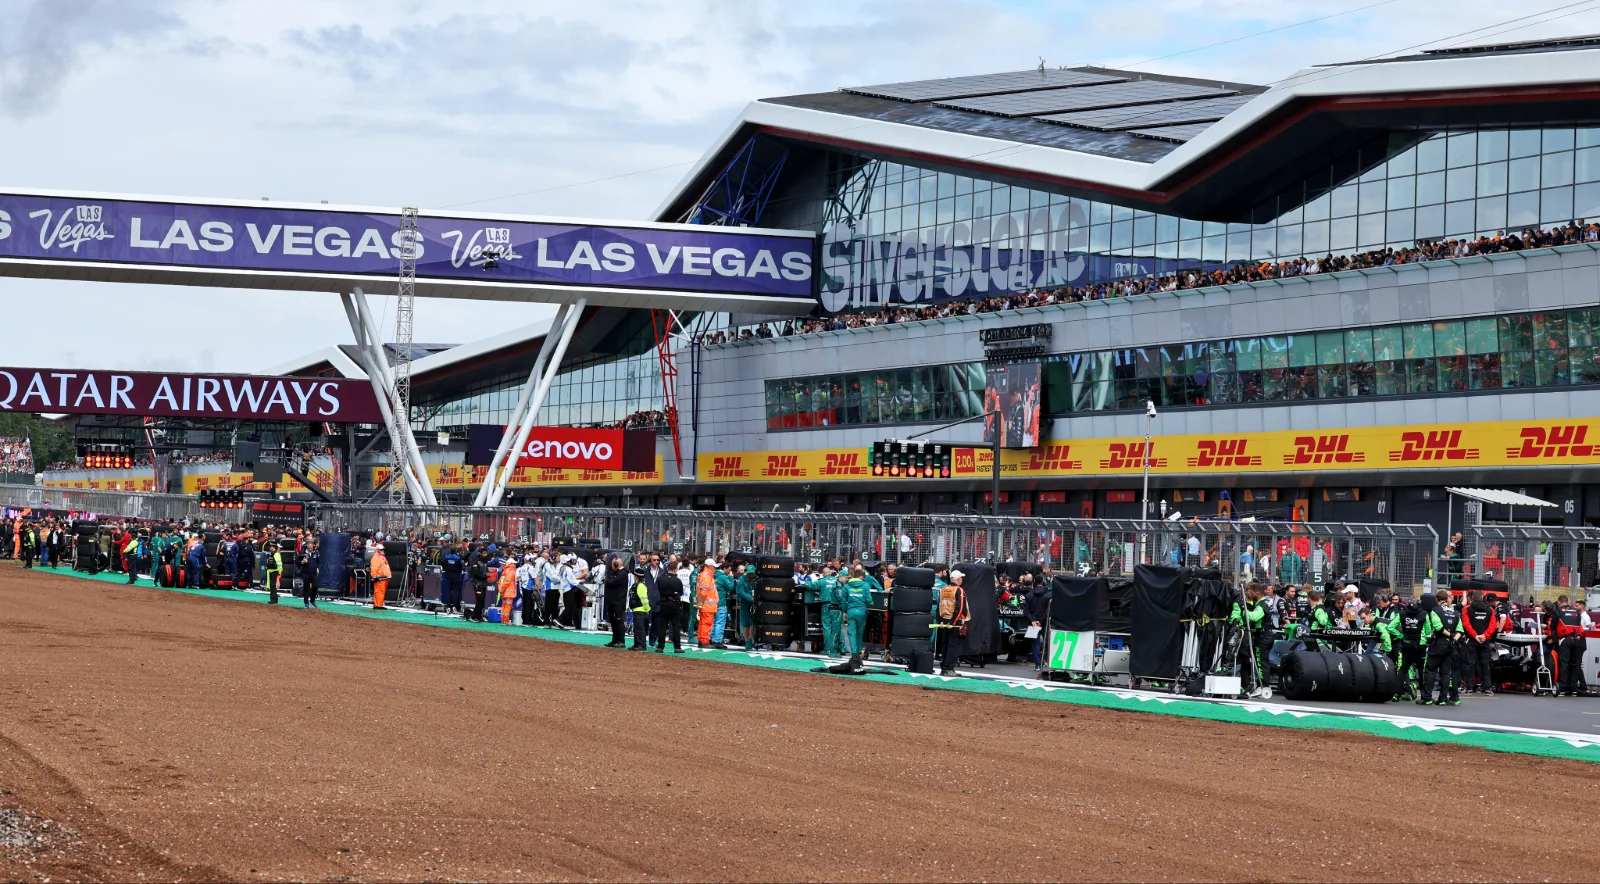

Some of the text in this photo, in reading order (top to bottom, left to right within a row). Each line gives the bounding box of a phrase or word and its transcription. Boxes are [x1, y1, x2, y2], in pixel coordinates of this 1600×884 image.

[78, 206, 101, 221] LAS
[29, 208, 115, 253] Vegas
[130, 217, 425, 260] LAS VEGAS
[486, 228, 509, 242] LAS
[441, 230, 522, 271] Vegas
[537, 237, 812, 281] LAS VEGAS
[819, 203, 1086, 313] Silverstone
[0, 370, 341, 416] QATAR AIRWAYS
[1196, 439, 1251, 467] DHL
[1293, 435, 1354, 465] DHL
[1401, 430, 1467, 461] DHL
[1519, 426, 1593, 459] DHL
[768, 455, 801, 476] DHL
[826, 453, 861, 475] DHL
[1028, 445, 1076, 470] DHL
[1107, 442, 1157, 469] DHL
[714, 457, 744, 477] DHL
[1377, 501, 1386, 514] 07
[1564, 500, 1575, 514] 05
[623, 539, 633, 547] 10
[673, 542, 684, 550] 55
[742, 546, 752, 554] 12
[810, 548, 822, 557] 22
[861, 551, 869, 560] 6
[974, 557, 987, 565] 23
[1314, 572, 1323, 582] 5
[1052, 631, 1080, 669] 27
